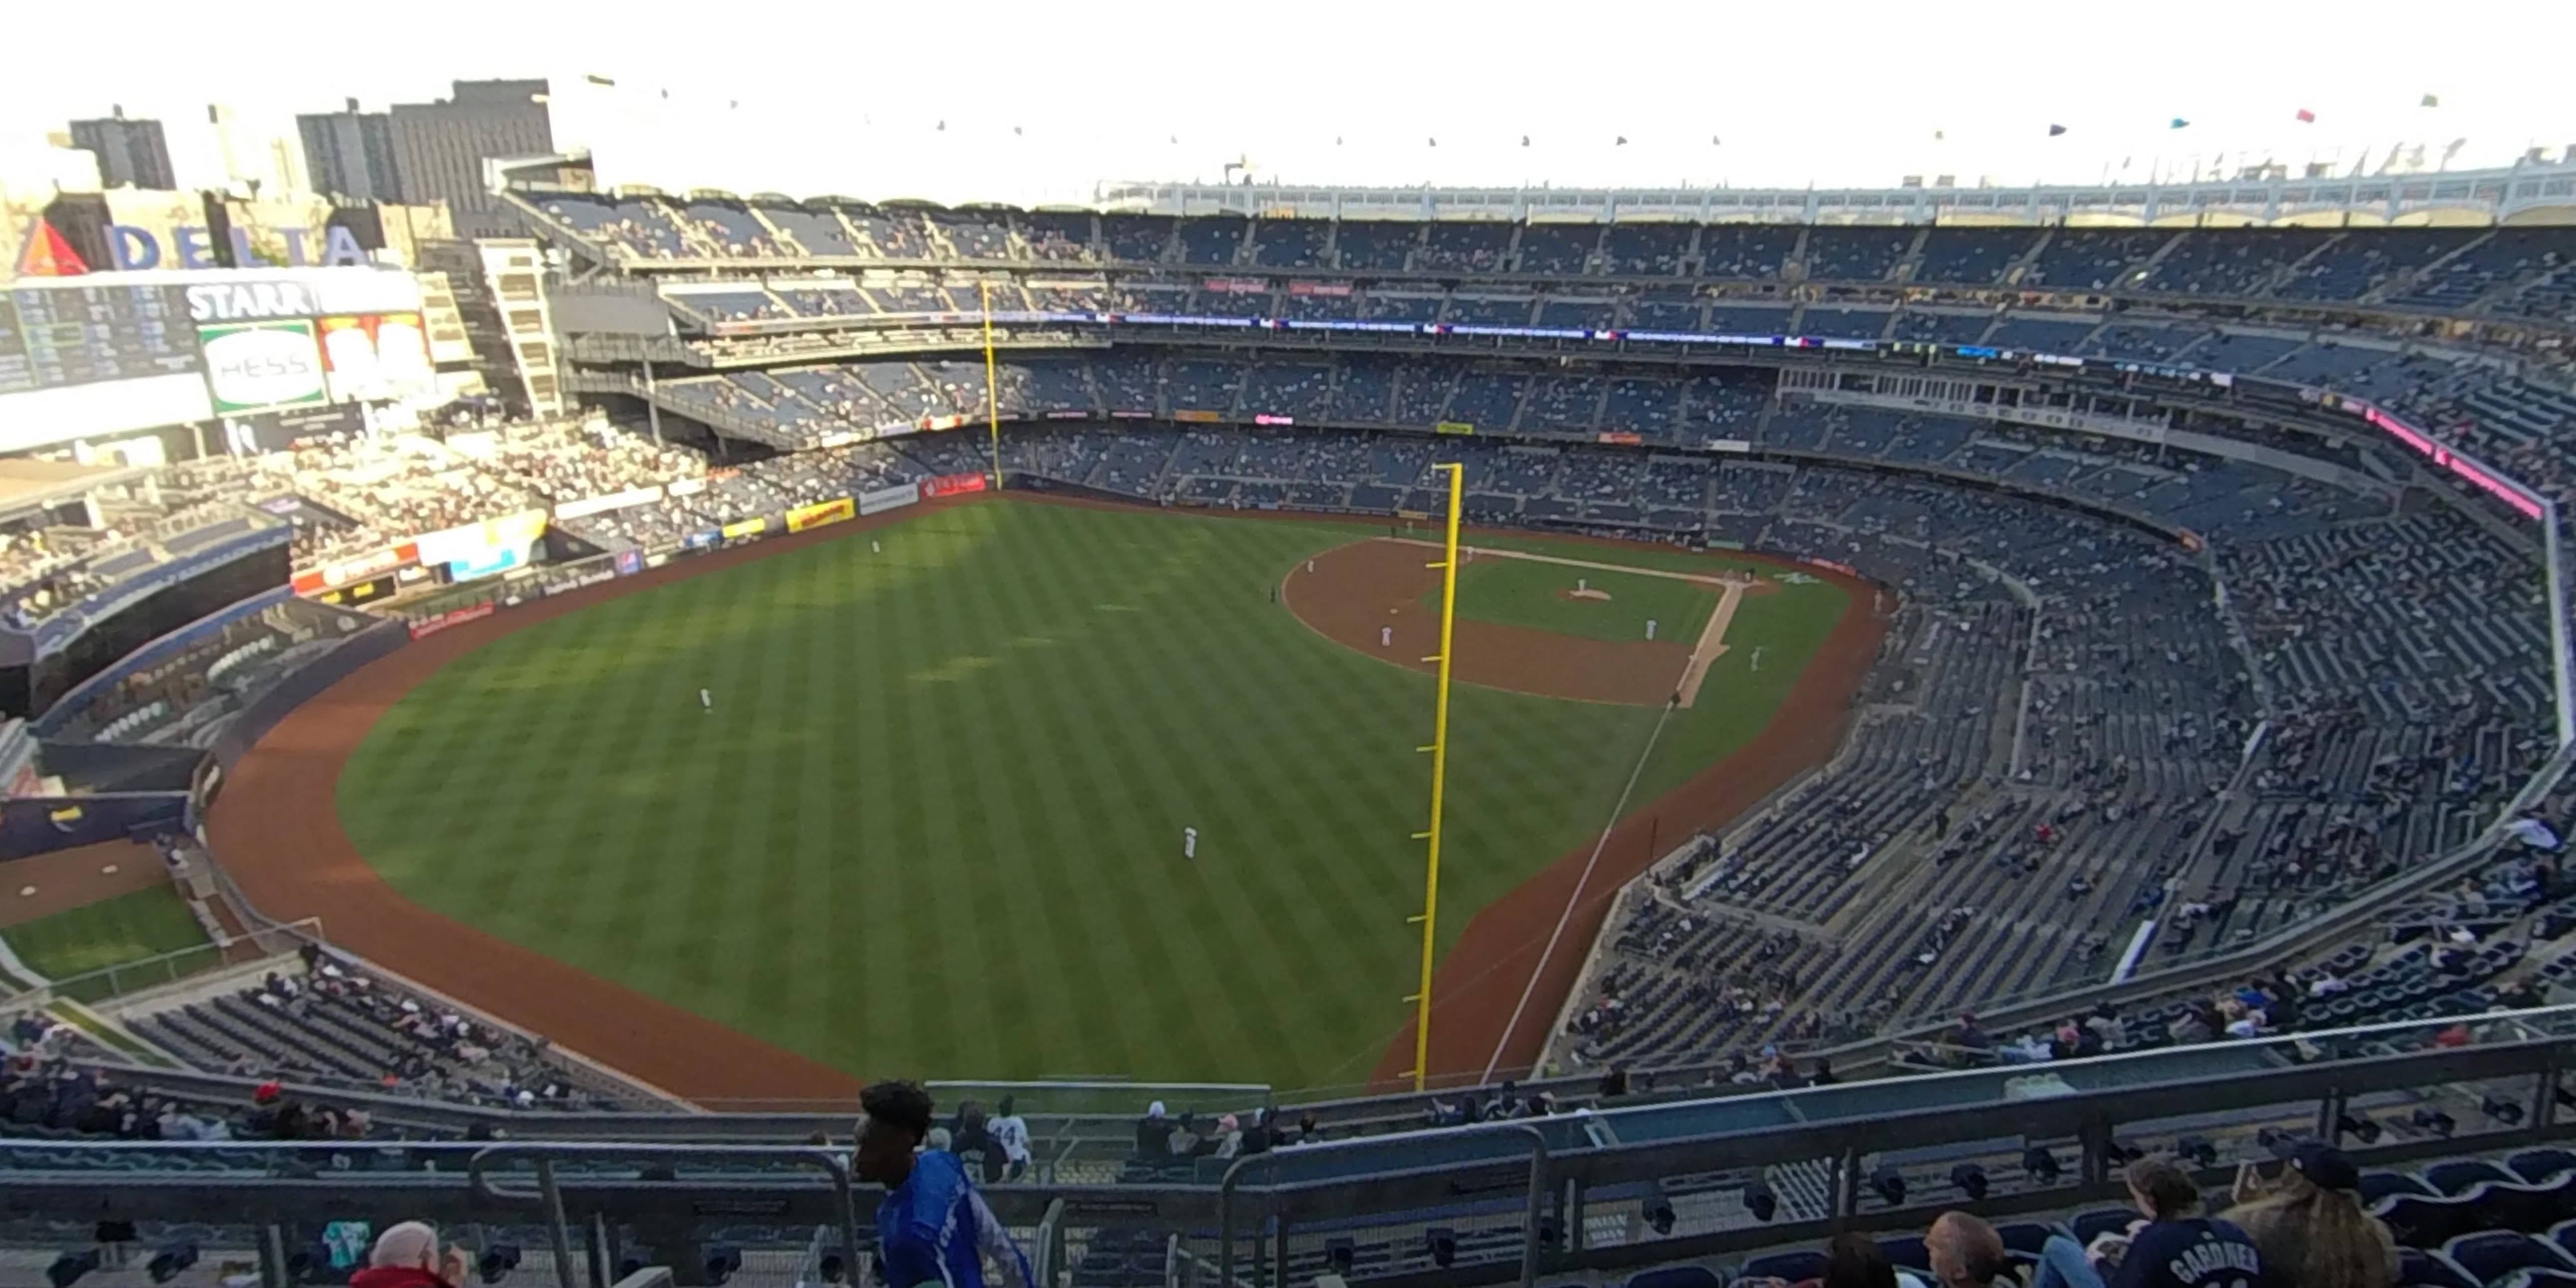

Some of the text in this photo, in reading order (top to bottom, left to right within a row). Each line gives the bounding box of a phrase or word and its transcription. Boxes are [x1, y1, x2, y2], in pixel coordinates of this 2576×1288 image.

[103, 225, 375, 270] DELTA
[185, 283, 312, 320] STARR
[221, 353, 310, 377] HESS
[992, 1125, 1016, 1146] 44
